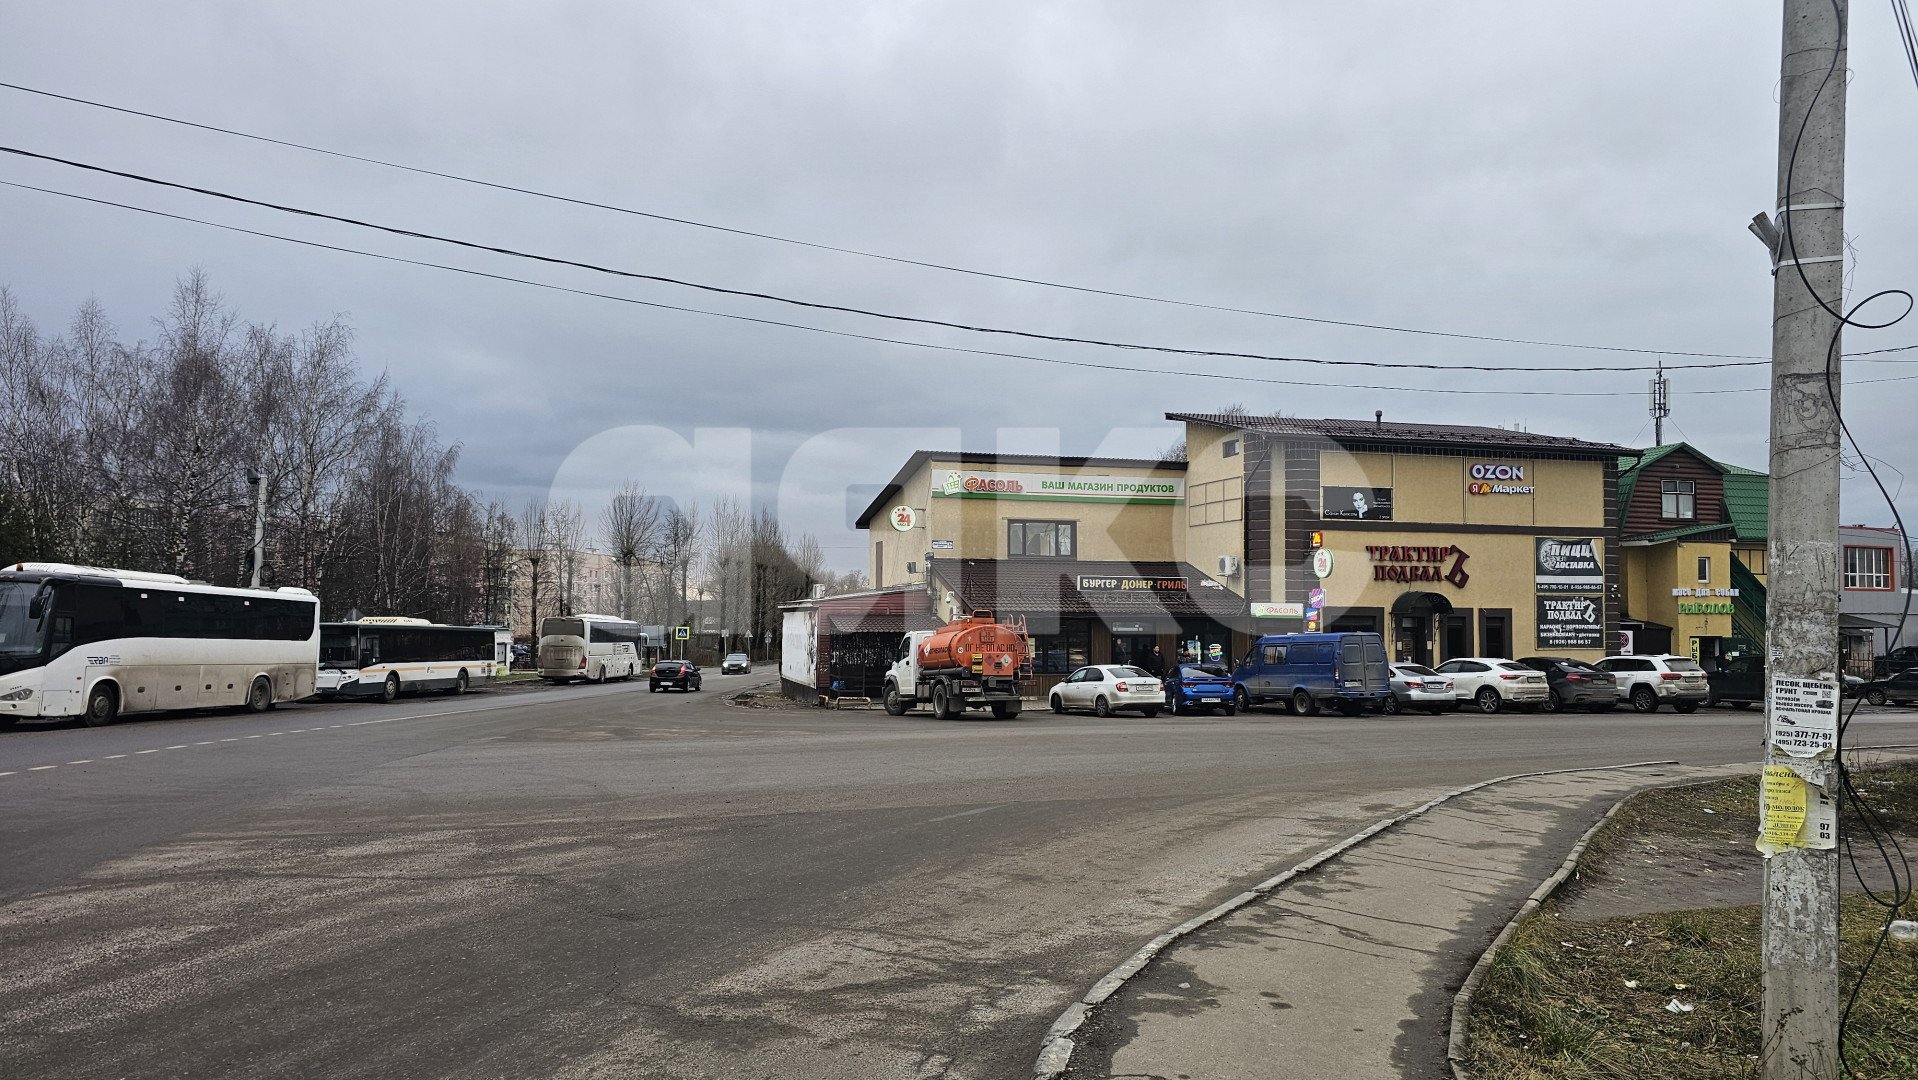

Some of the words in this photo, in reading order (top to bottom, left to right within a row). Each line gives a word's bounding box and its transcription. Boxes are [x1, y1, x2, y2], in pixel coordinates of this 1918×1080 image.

[1472, 464, 1524, 480] OZON
[963, 475, 1023, 492] ФАСОЛЬ
[1041, 481, 1065, 490] ВАШ
[1067, 482, 1114, 492] МАГАЗИН
[1116, 483, 1175, 493] ПРОДУКТОВ
[1492, 484, 1535, 495] Маркет
[897, 513, 911, 526] 24
[1551, 544, 1593, 557] ПИЦЦ
[1555, 561, 1595, 569] ДОСТАВКА
[1082, 578, 1118, 588] БУРГЕР
[1121, 579, 1153, 590] ДОНЕР
[1157, 580, 1187, 590] ГРИЛЬ
[1266, 606, 1299, 614] ФАСОЛЬ
[1678, 602, 1735, 614] РЫБОЛОВ
[1775, 687, 1797, 695] ГРУНТ
[1794, 730, 1832, 741] 377-77-97
[1793, 739, 1832, 749] 723-25-03
